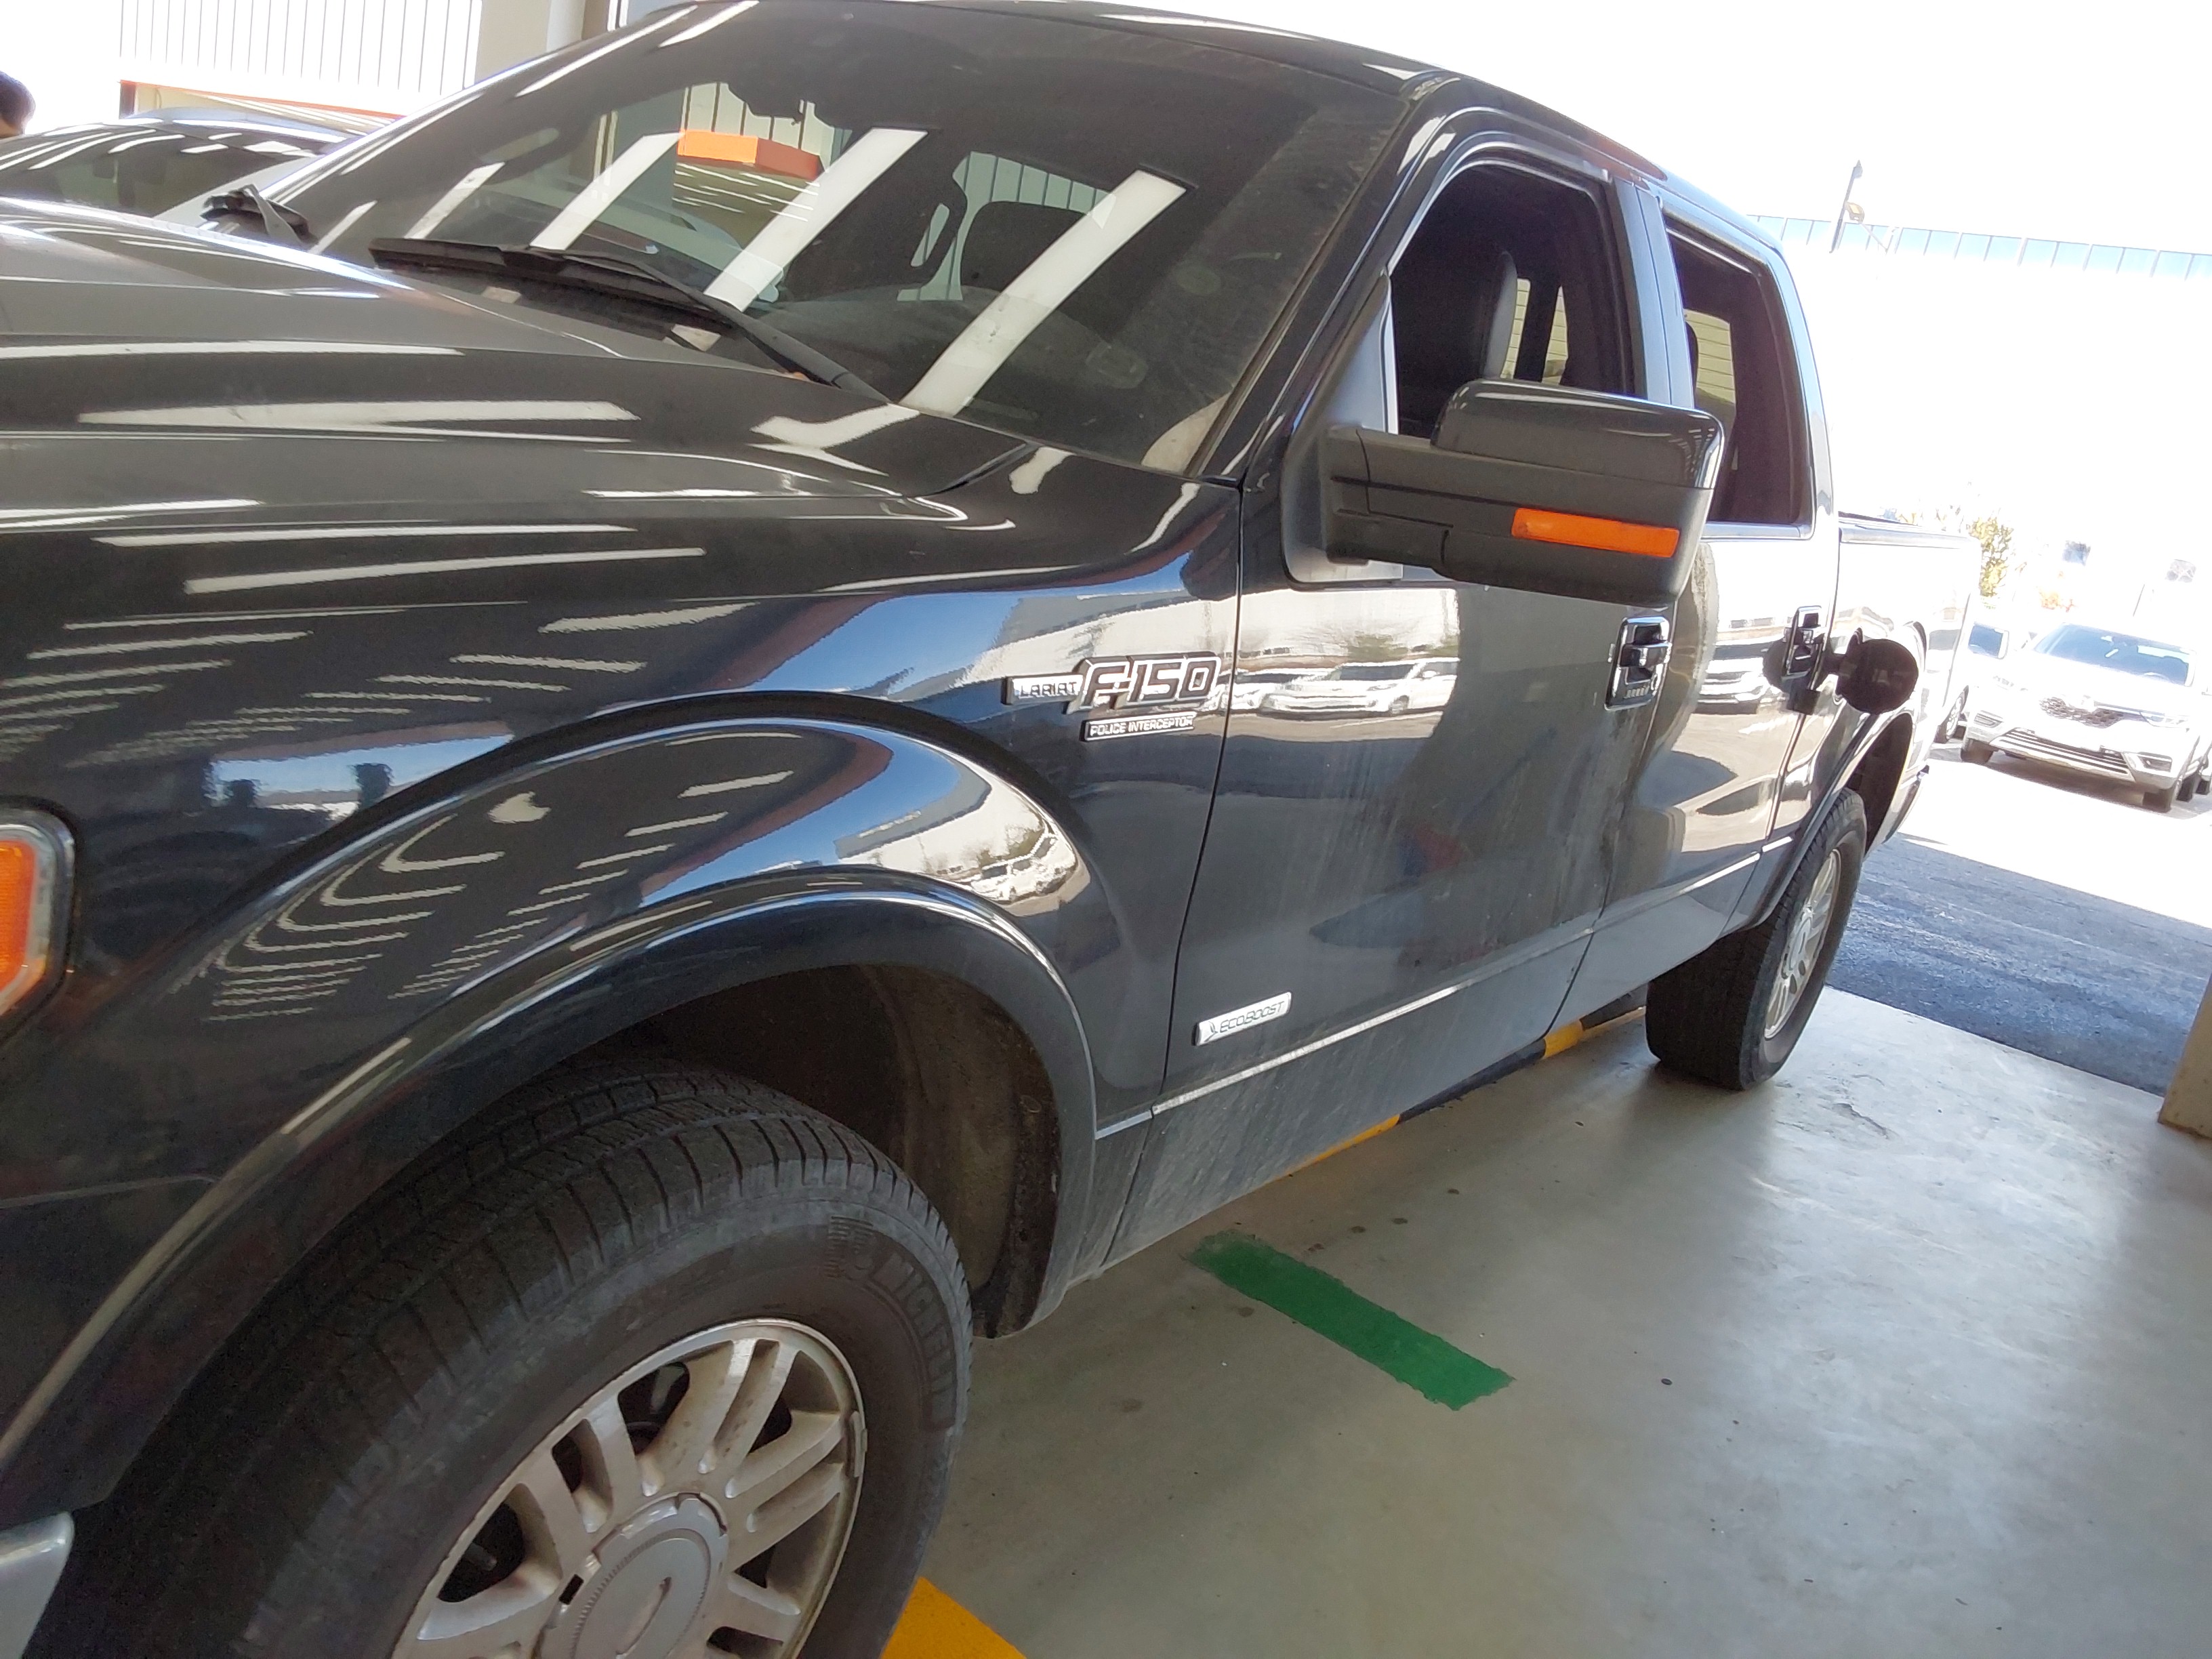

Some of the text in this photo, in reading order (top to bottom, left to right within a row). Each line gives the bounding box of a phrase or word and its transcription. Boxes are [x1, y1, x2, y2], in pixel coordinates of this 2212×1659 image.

[1019, 681, 1078, 697] LARIAT
[1090, 715, 1194, 737] POLICE INTERCEPTOR
[1219, 1000, 1285, 1033] ECOBOOST
